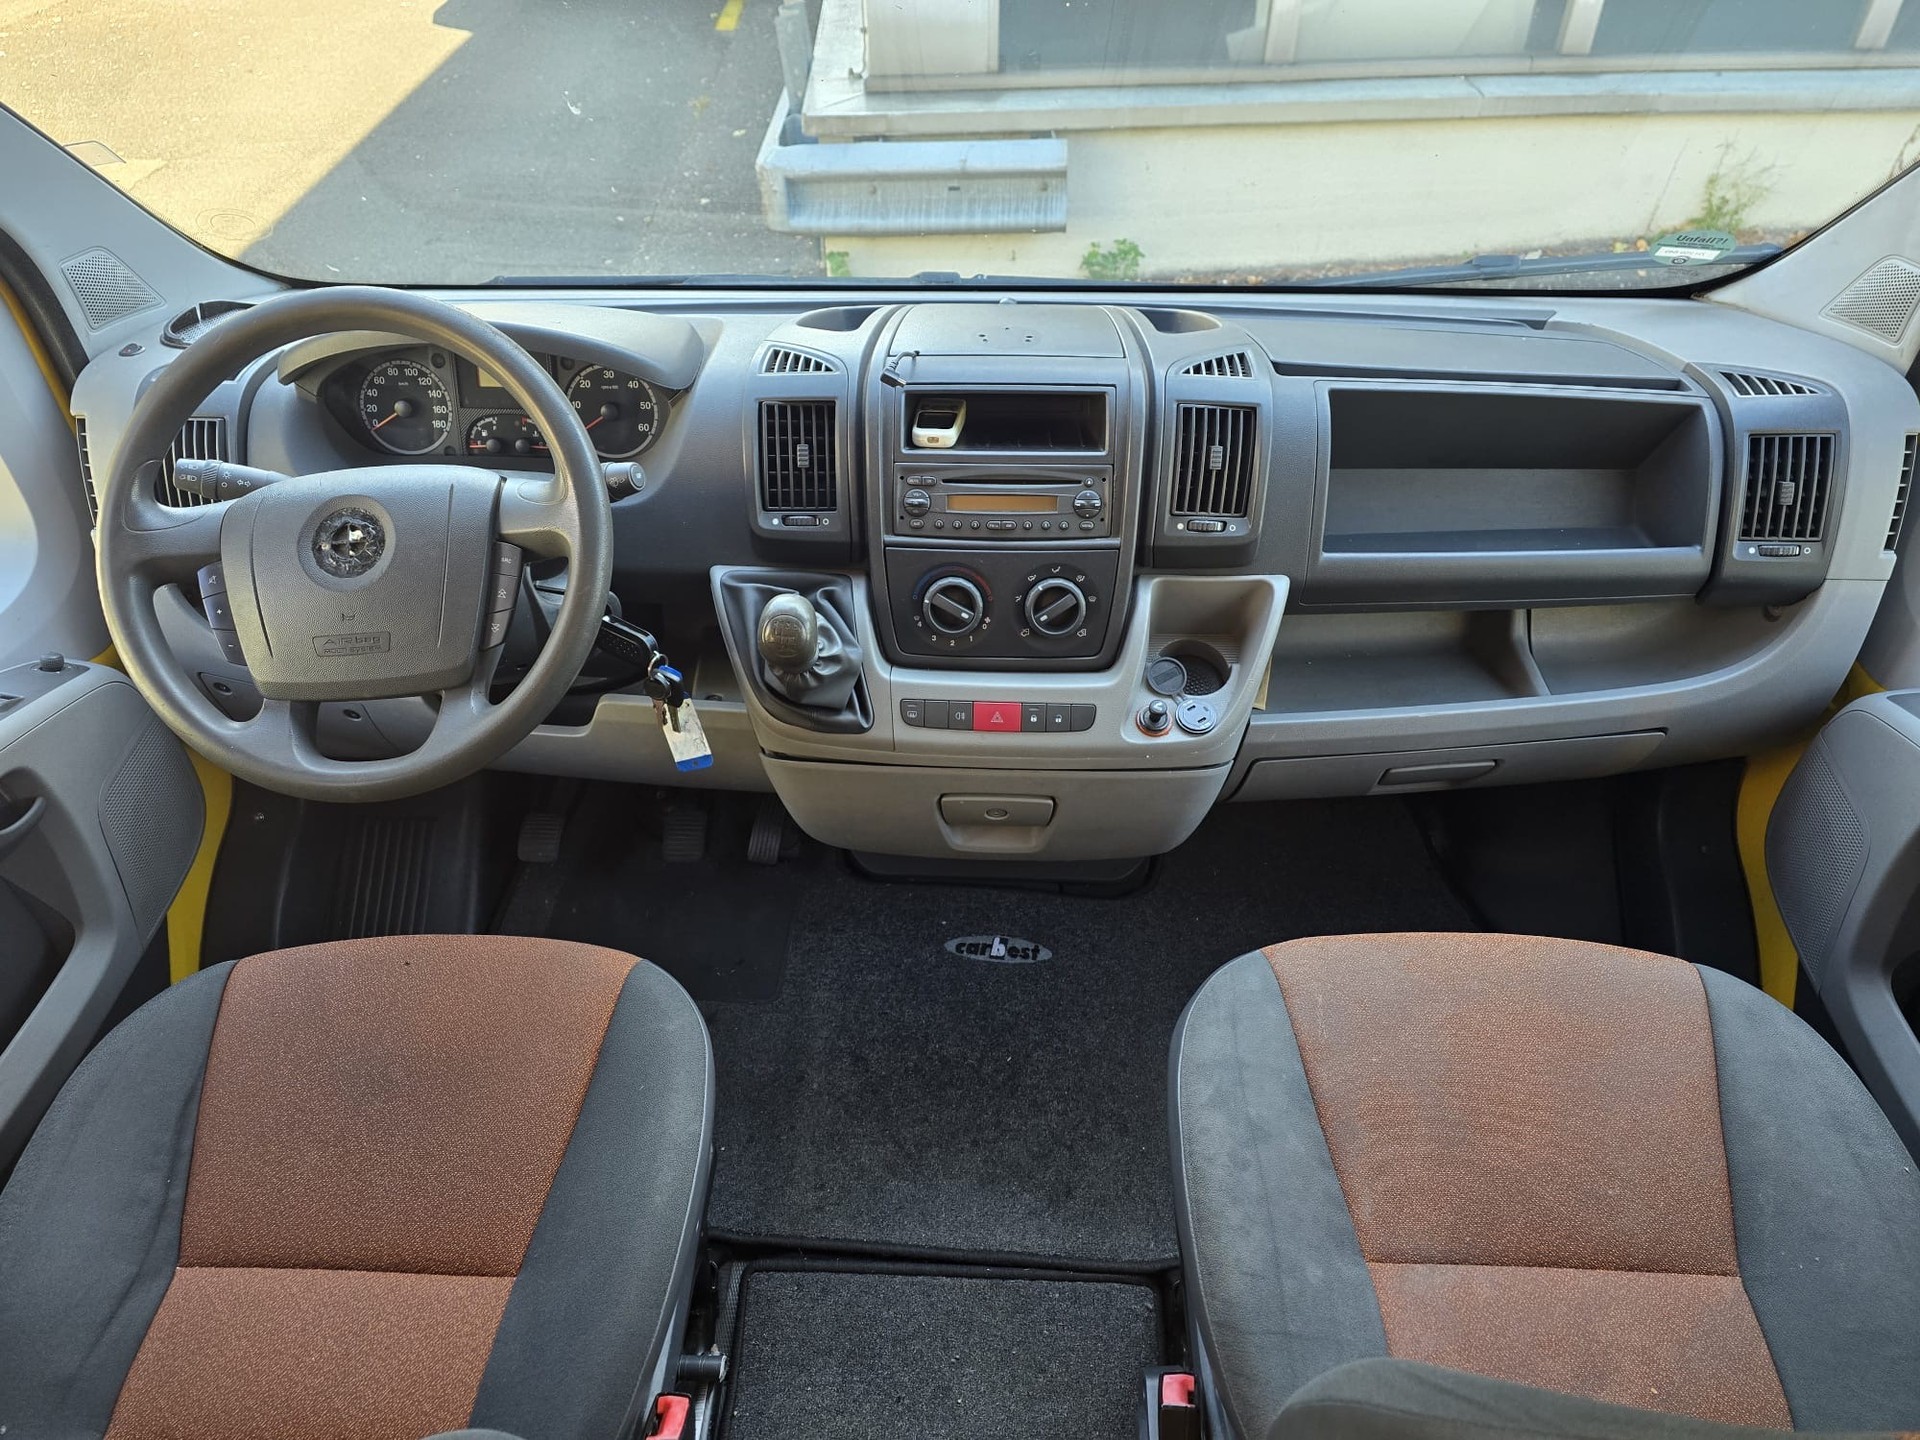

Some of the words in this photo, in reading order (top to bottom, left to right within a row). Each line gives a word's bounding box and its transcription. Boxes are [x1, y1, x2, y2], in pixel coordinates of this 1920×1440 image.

[1676, 234, 1728, 244] Unfall?!
[388, 368, 398, 376] 80
[404, 368, 418, 376] 100
[603, 370, 614, 378] 30
[374, 376, 385, 384] 60
[418, 377, 432, 386] 120
[580, 380, 591, 388] 20
[628, 380, 638, 388] 40
[428, 390, 442, 398] 140
[432, 406, 446, 414] 160
[640, 402, 651, 410] 50
[372, 419, 378, 427] 0
[638, 424, 649, 432] 60
[955, 936, 1041, 960] carbest
